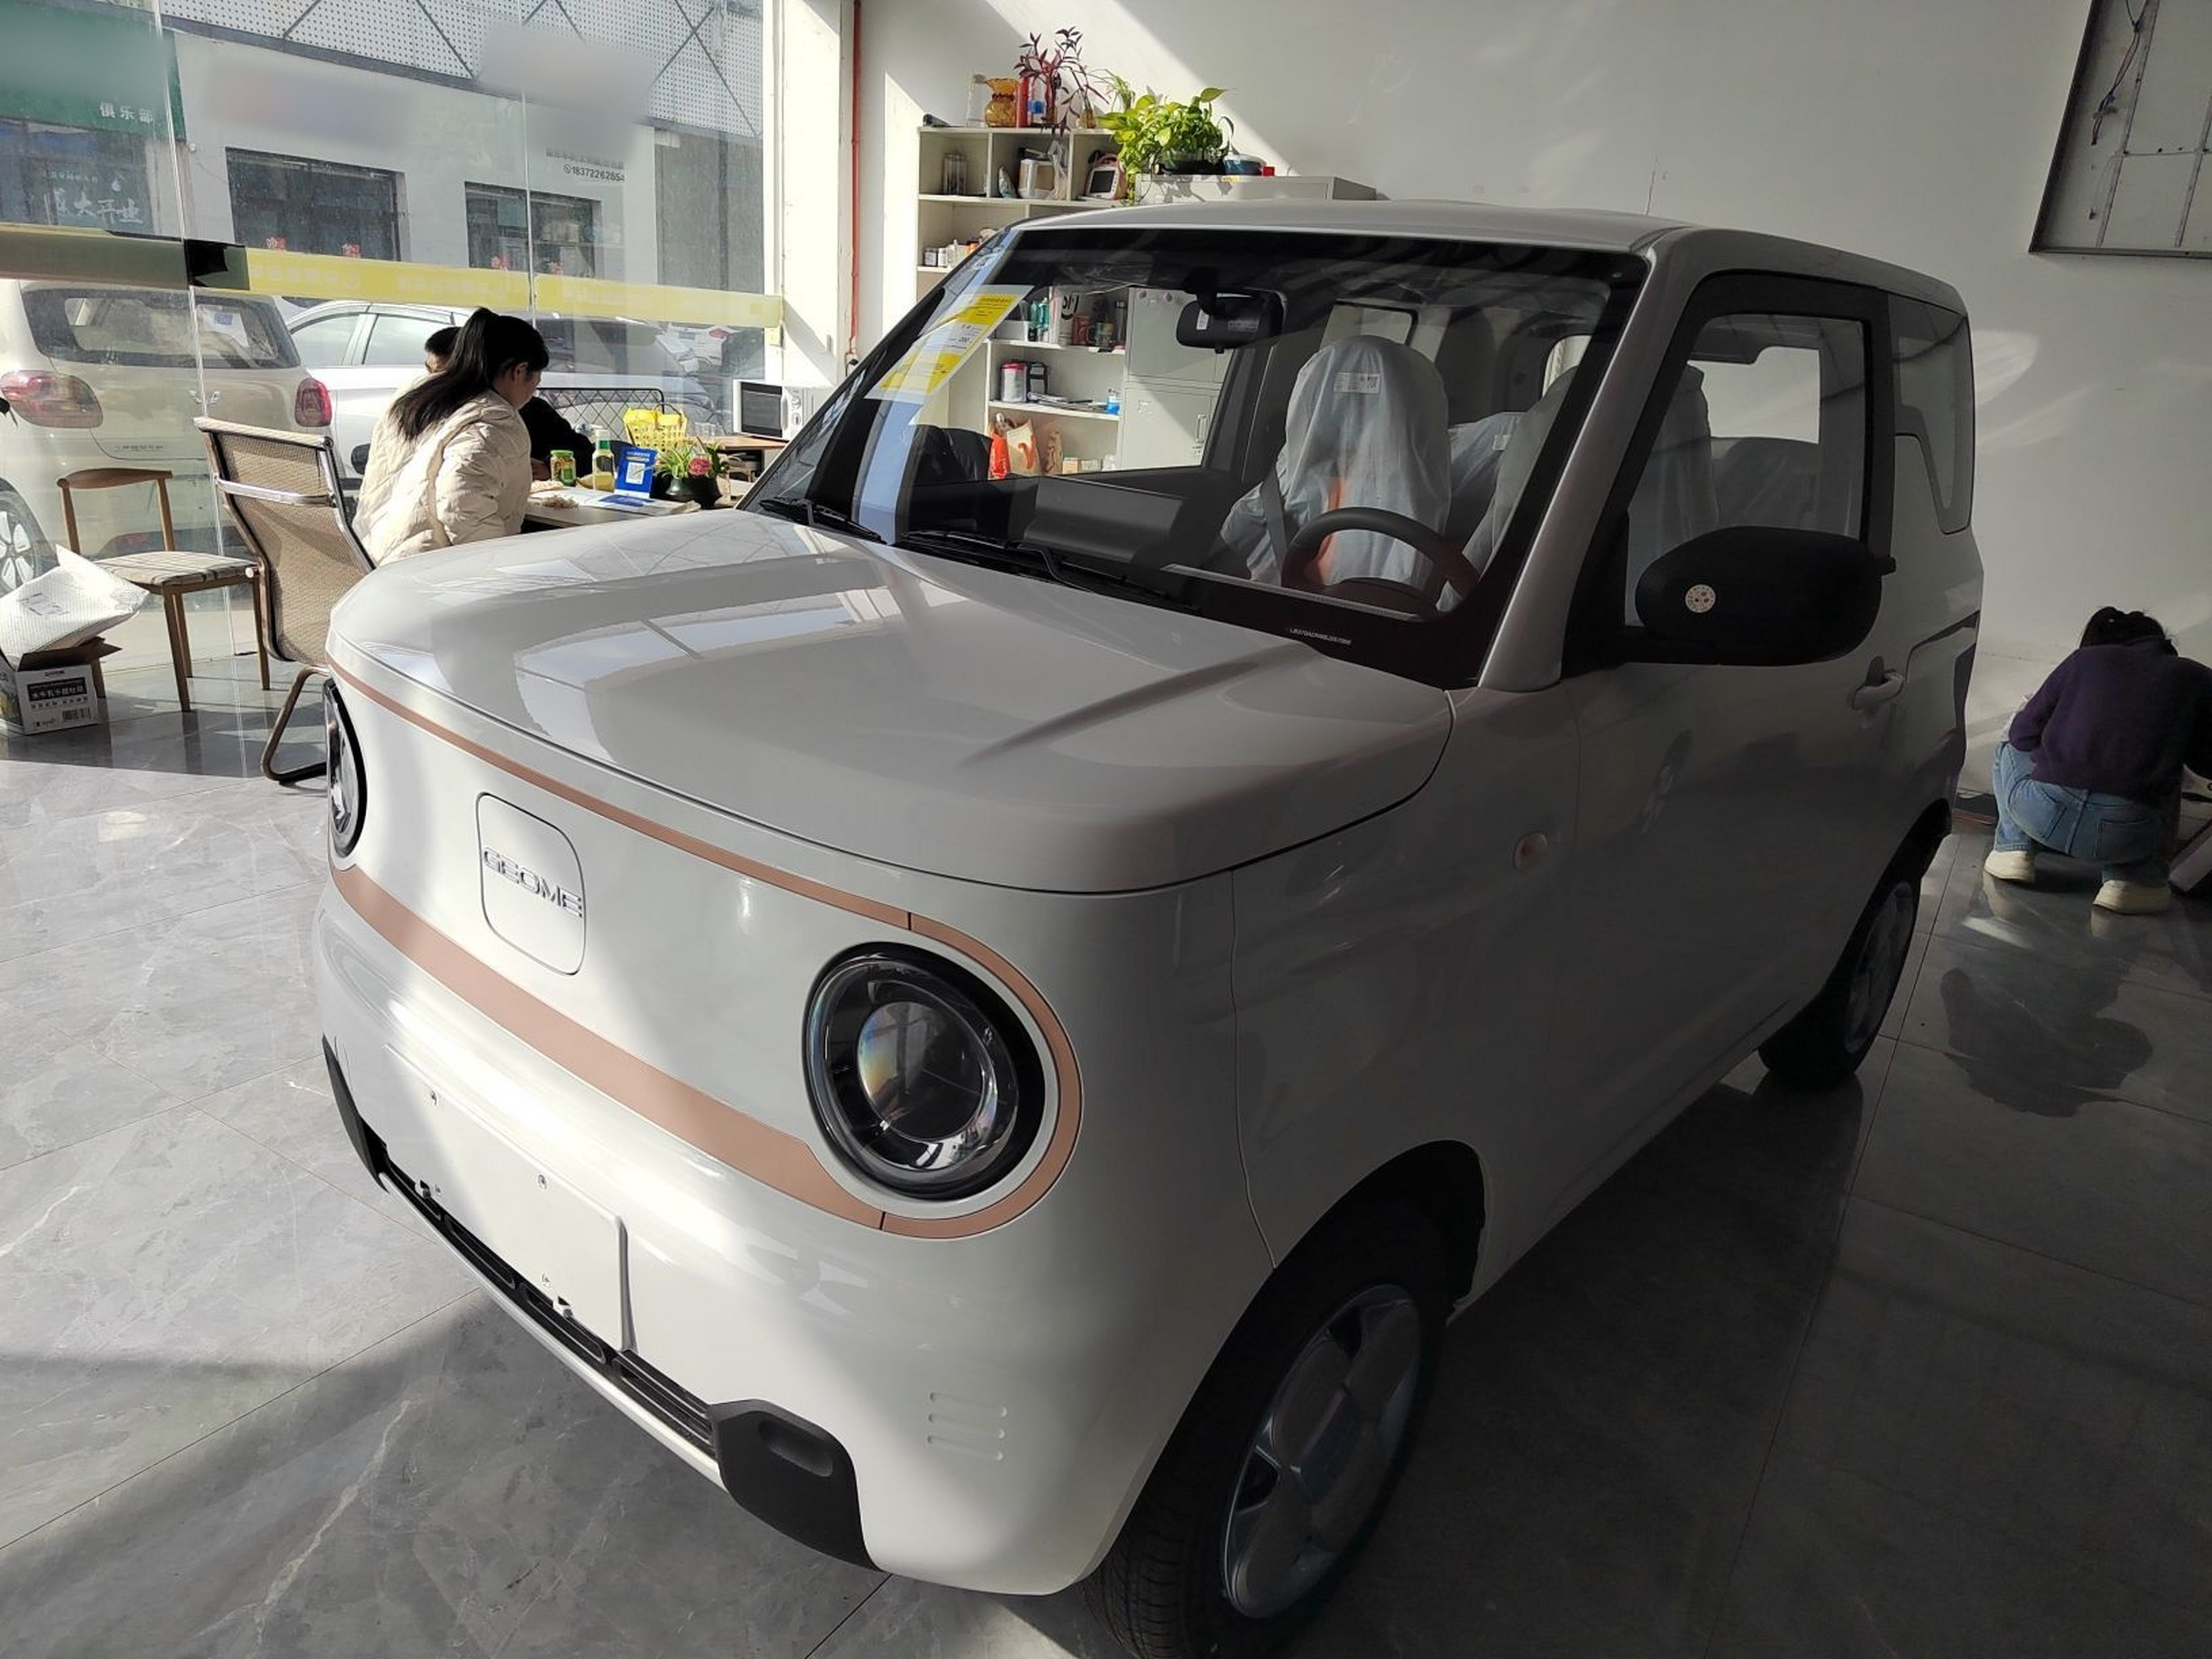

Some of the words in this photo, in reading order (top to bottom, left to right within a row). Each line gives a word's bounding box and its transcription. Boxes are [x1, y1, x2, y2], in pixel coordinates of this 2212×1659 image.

[100, 102, 154, 124] 俱乐部
[484, 847, 582, 918] GEOME
